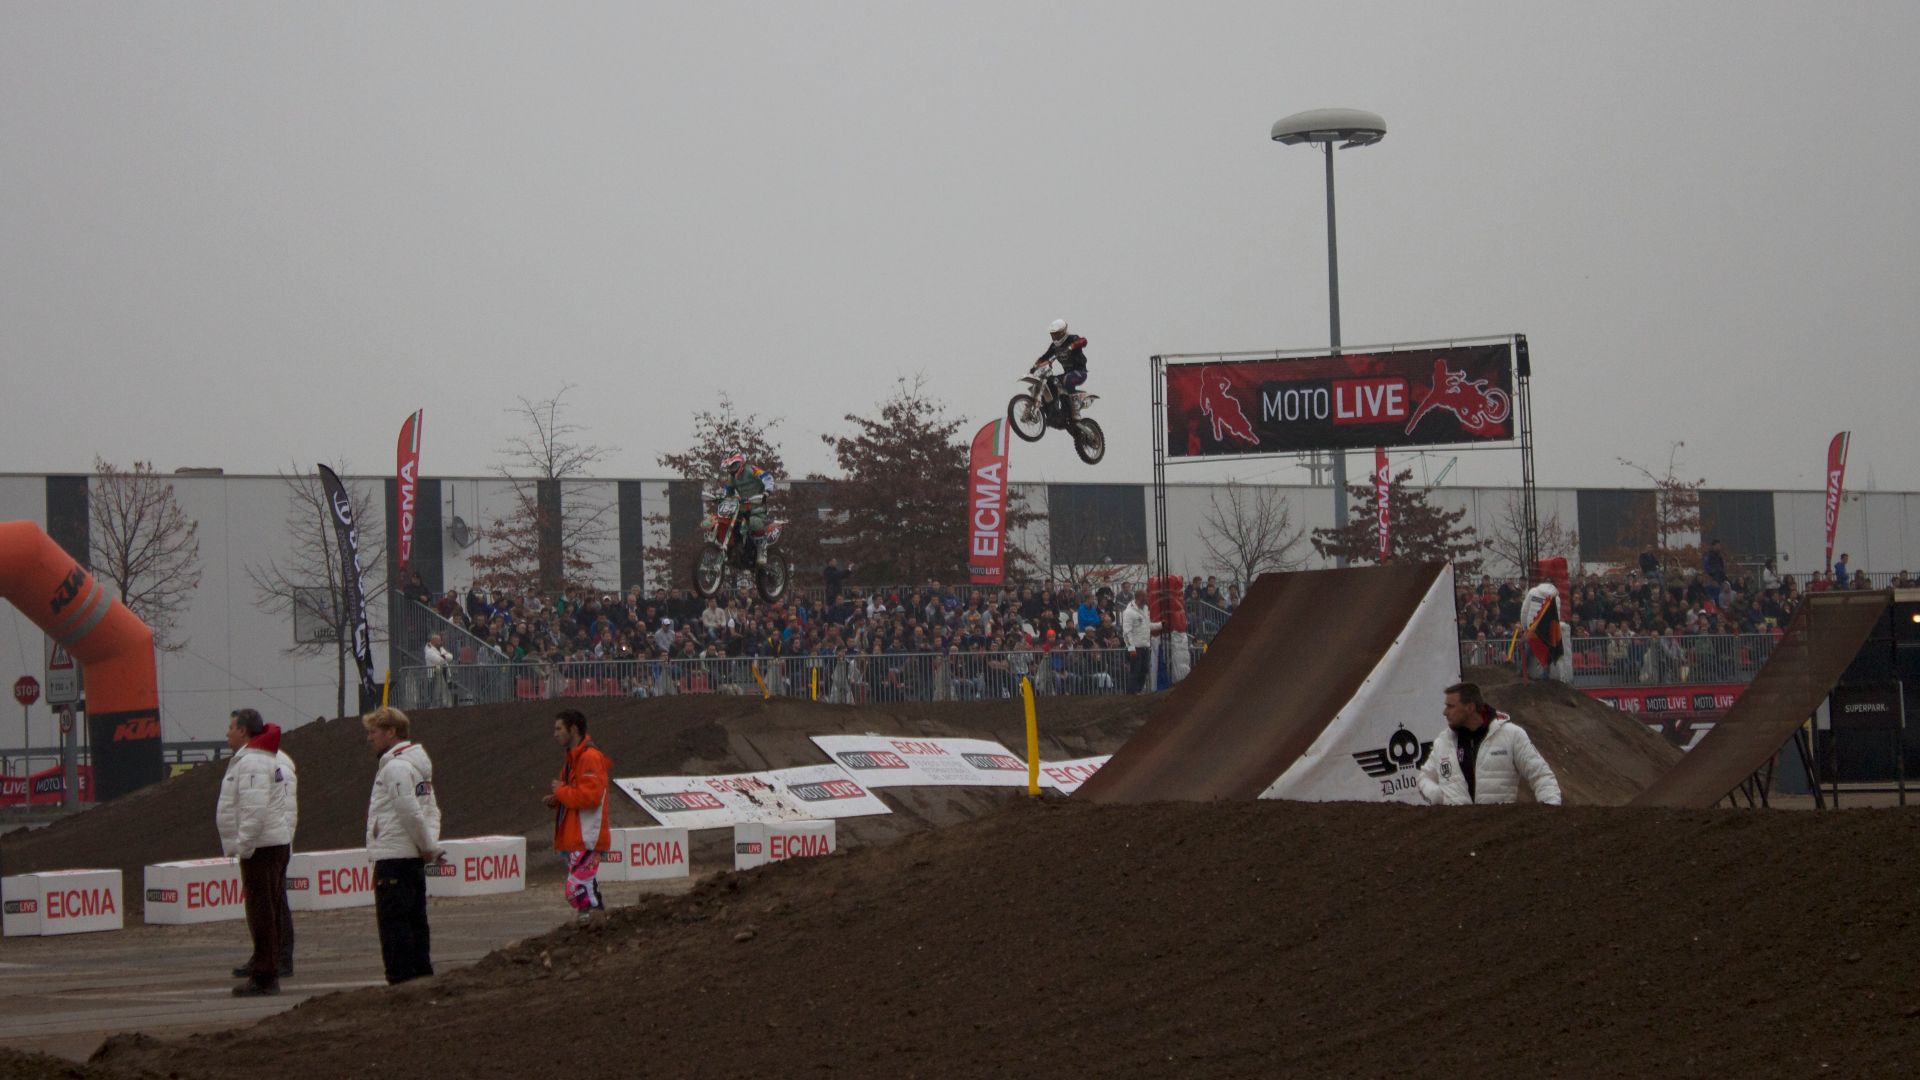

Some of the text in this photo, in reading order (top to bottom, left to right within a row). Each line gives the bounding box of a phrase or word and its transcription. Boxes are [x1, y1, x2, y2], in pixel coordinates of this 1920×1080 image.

[1263, 383, 1404, 423] MOTO LIVE
[973, 462, 1002, 557] EICMA
[985, 567, 1001, 575] LIVE
[15, 685, 38, 697] STOP
[1646, 697, 1687, 711] MOTO LIVE
[1694, 697, 1714, 709] MOTO
[890, 740, 950, 756] EICMA
[842, 751, 905, 769] MOTO LIVE
[991, 754, 1025, 770] LIVE
[1042, 762, 1106, 785] EICM
[3, 781, 27, 794] LIVE
[36, 778, 60, 792] MOTO
[795, 780, 864, 800] MOTO LIVE
[645, 793, 723, 813] MOTO LIVE
[630, 840, 684, 867] EICMA
[769, 834, 830, 859] EICMA
[608, 852, 621, 862] LIVE
[440, 865, 456, 876] LIVE
[464, 853, 521, 882] EICMA
[294, 879, 308, 889] LIVE
[46, 887, 116, 919] EICMA
[161, 891, 177, 902] LIVE
[19, 901, 36, 912] LIVE
